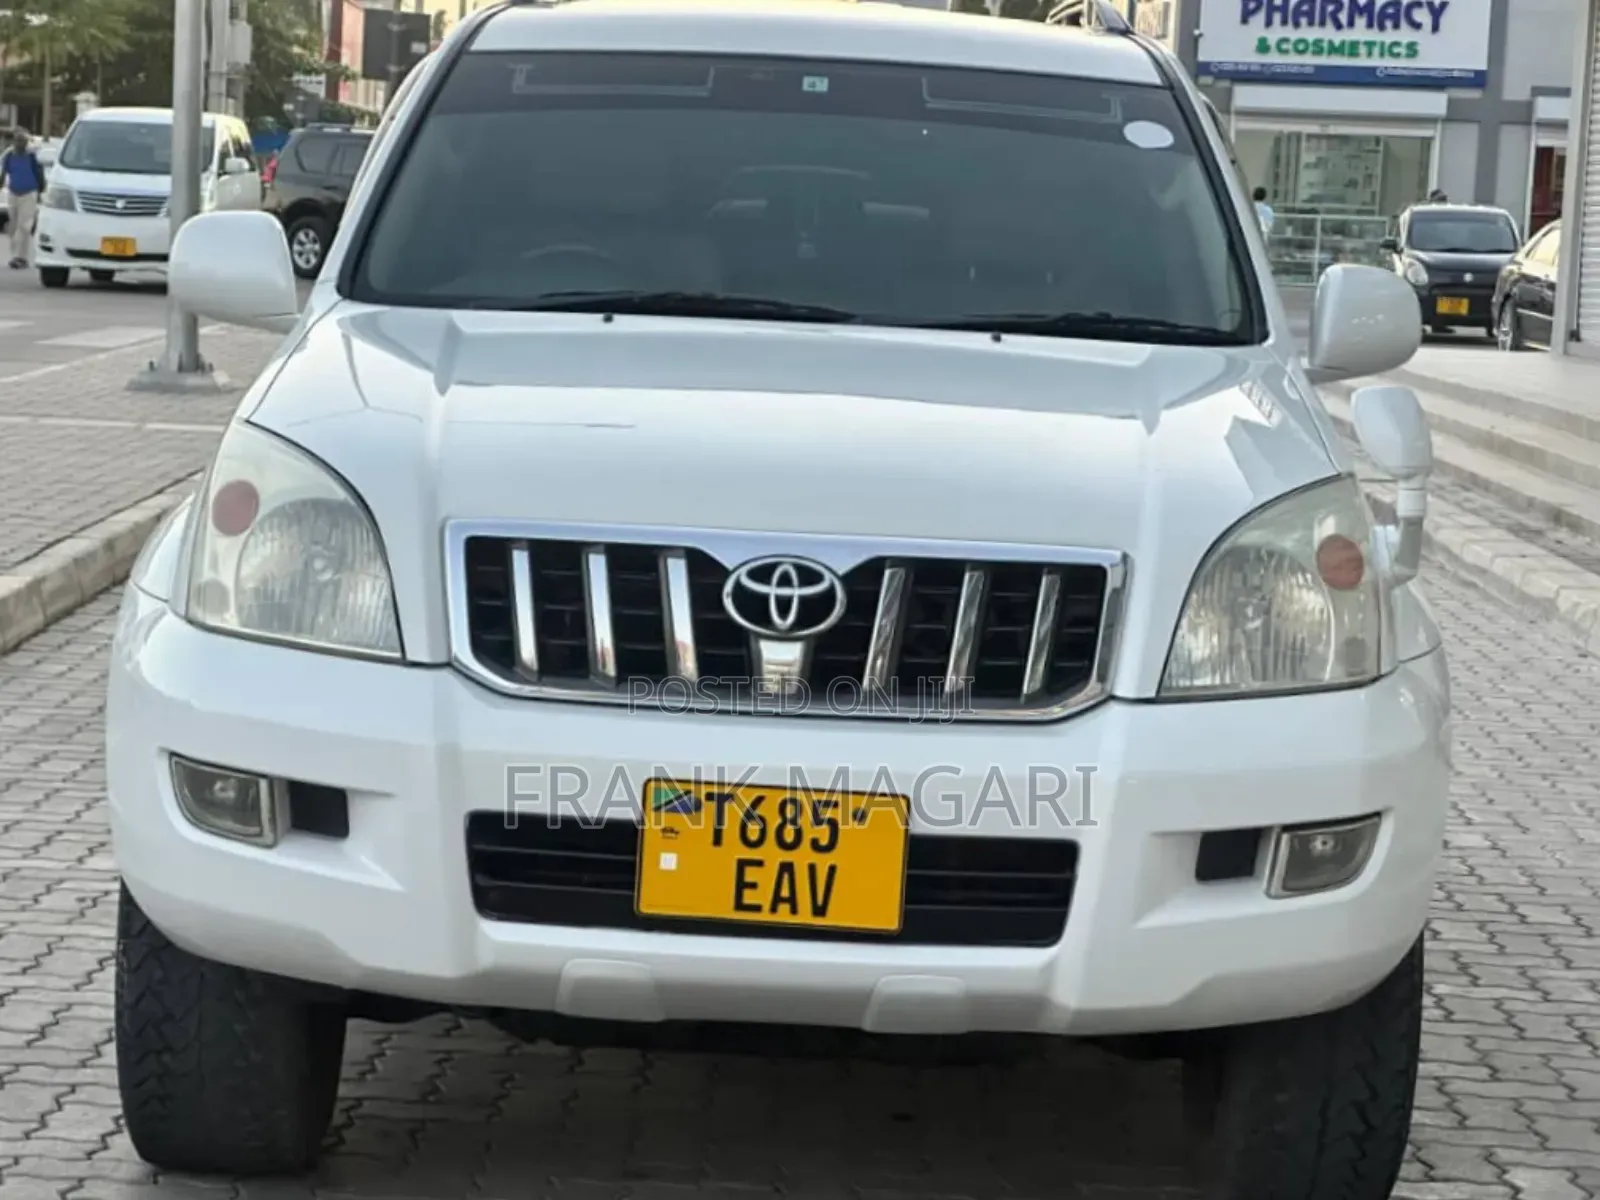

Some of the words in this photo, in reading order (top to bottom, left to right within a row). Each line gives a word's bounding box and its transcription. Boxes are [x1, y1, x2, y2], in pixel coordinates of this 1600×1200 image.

[1240, 0, 1450, 33] PHARMACY
[1256, 36, 1271, 54] &
[1275, 37, 1420, 59] COSMETICS
[705, 791, 840, 854] T685
[733, 858, 838, 918] EAV
